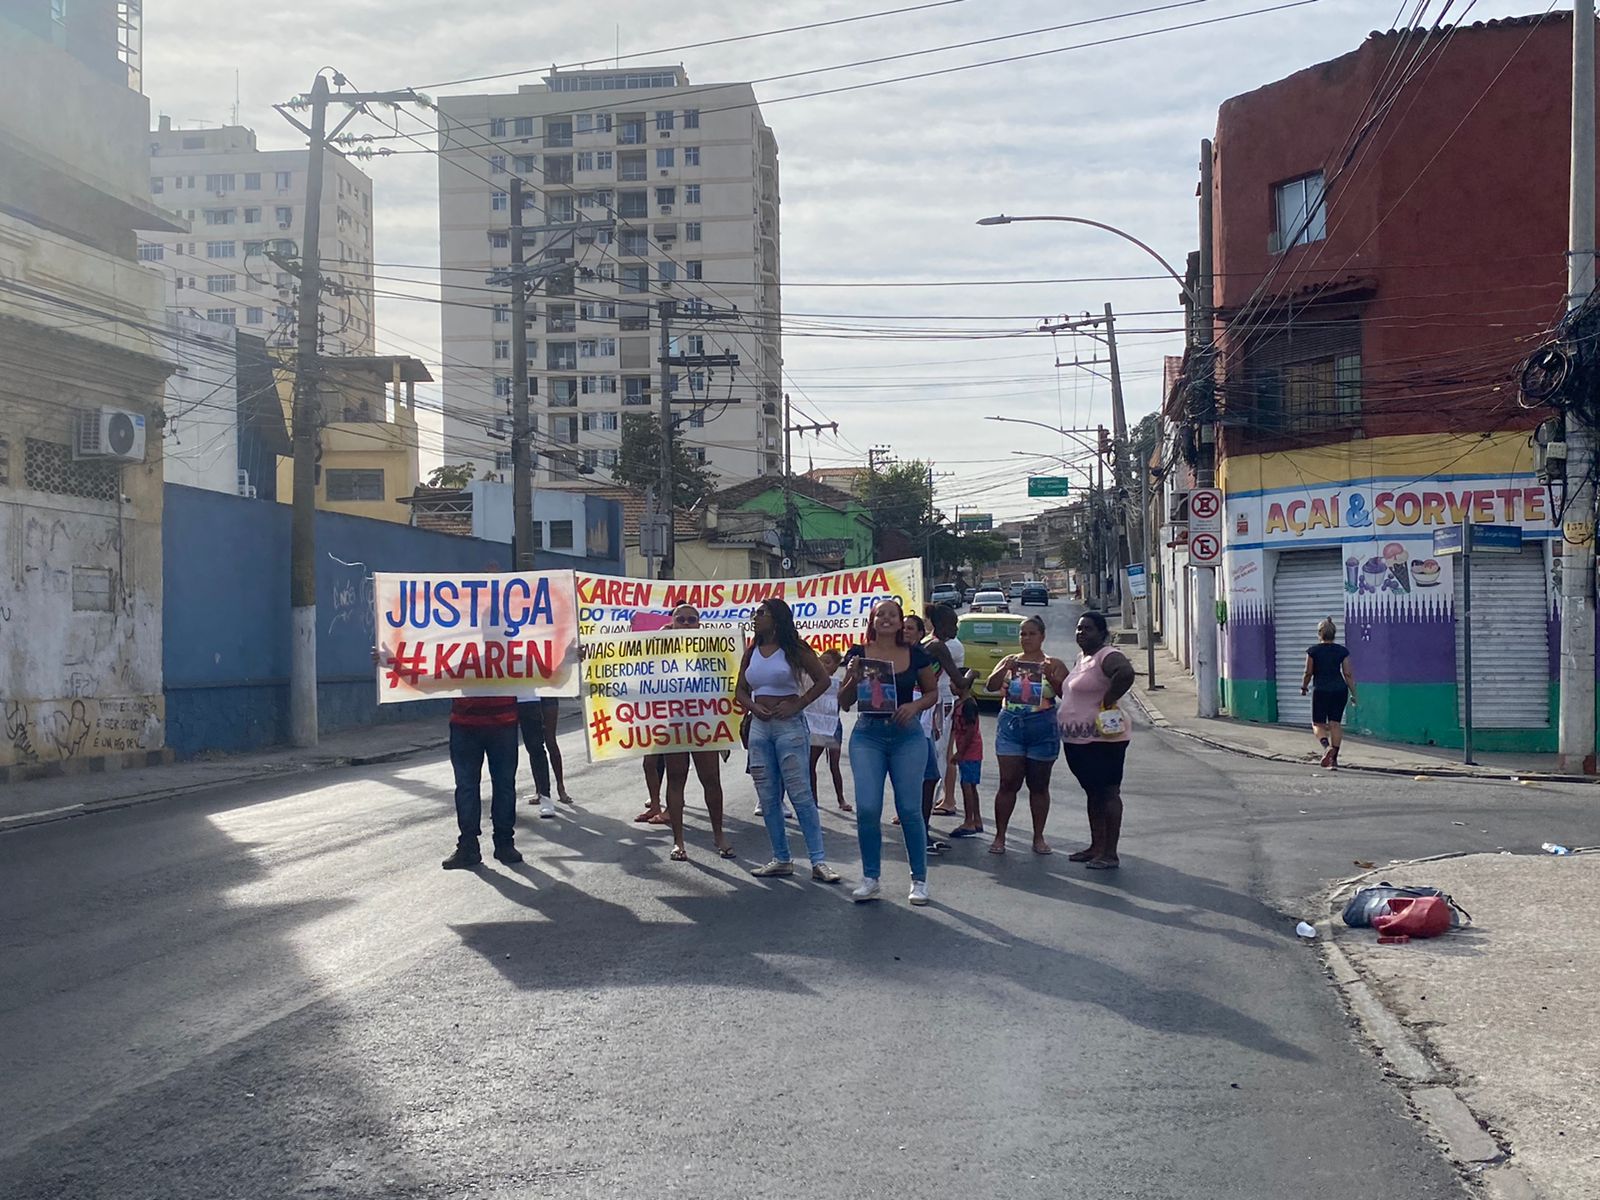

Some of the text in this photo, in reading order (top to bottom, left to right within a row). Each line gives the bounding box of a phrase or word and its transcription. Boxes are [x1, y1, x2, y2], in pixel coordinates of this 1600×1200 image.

[1265, 491, 1341, 537] AÇAÍ
[1345, 493, 1372, 528] &
[1375, 487, 1546, 527] SORVETE
[576, 577, 652, 607] KAREN
[662, 584, 725, 609] MAIS
[731, 581, 786, 604] UMA
[385, 577, 554, 637] JUSTIÇA
[580, 607, 604, 621] DO
[827, 599, 852, 616] DE
[852, 619, 859, 628] E
[584, 642, 615, 660] MAIS
[618, 639, 643, 657] UMA
[686, 636, 736, 653] PEDIMOS
[385, 639, 553, 689] #KAREN
[585, 657, 727, 681] A LIBERDADE DA KAREN
[590, 676, 735, 699] PRESA INJUSTAMENTE
[615, 697, 747, 724] QUEREMOS
[619, 720, 735, 750] JUSTIÇA
